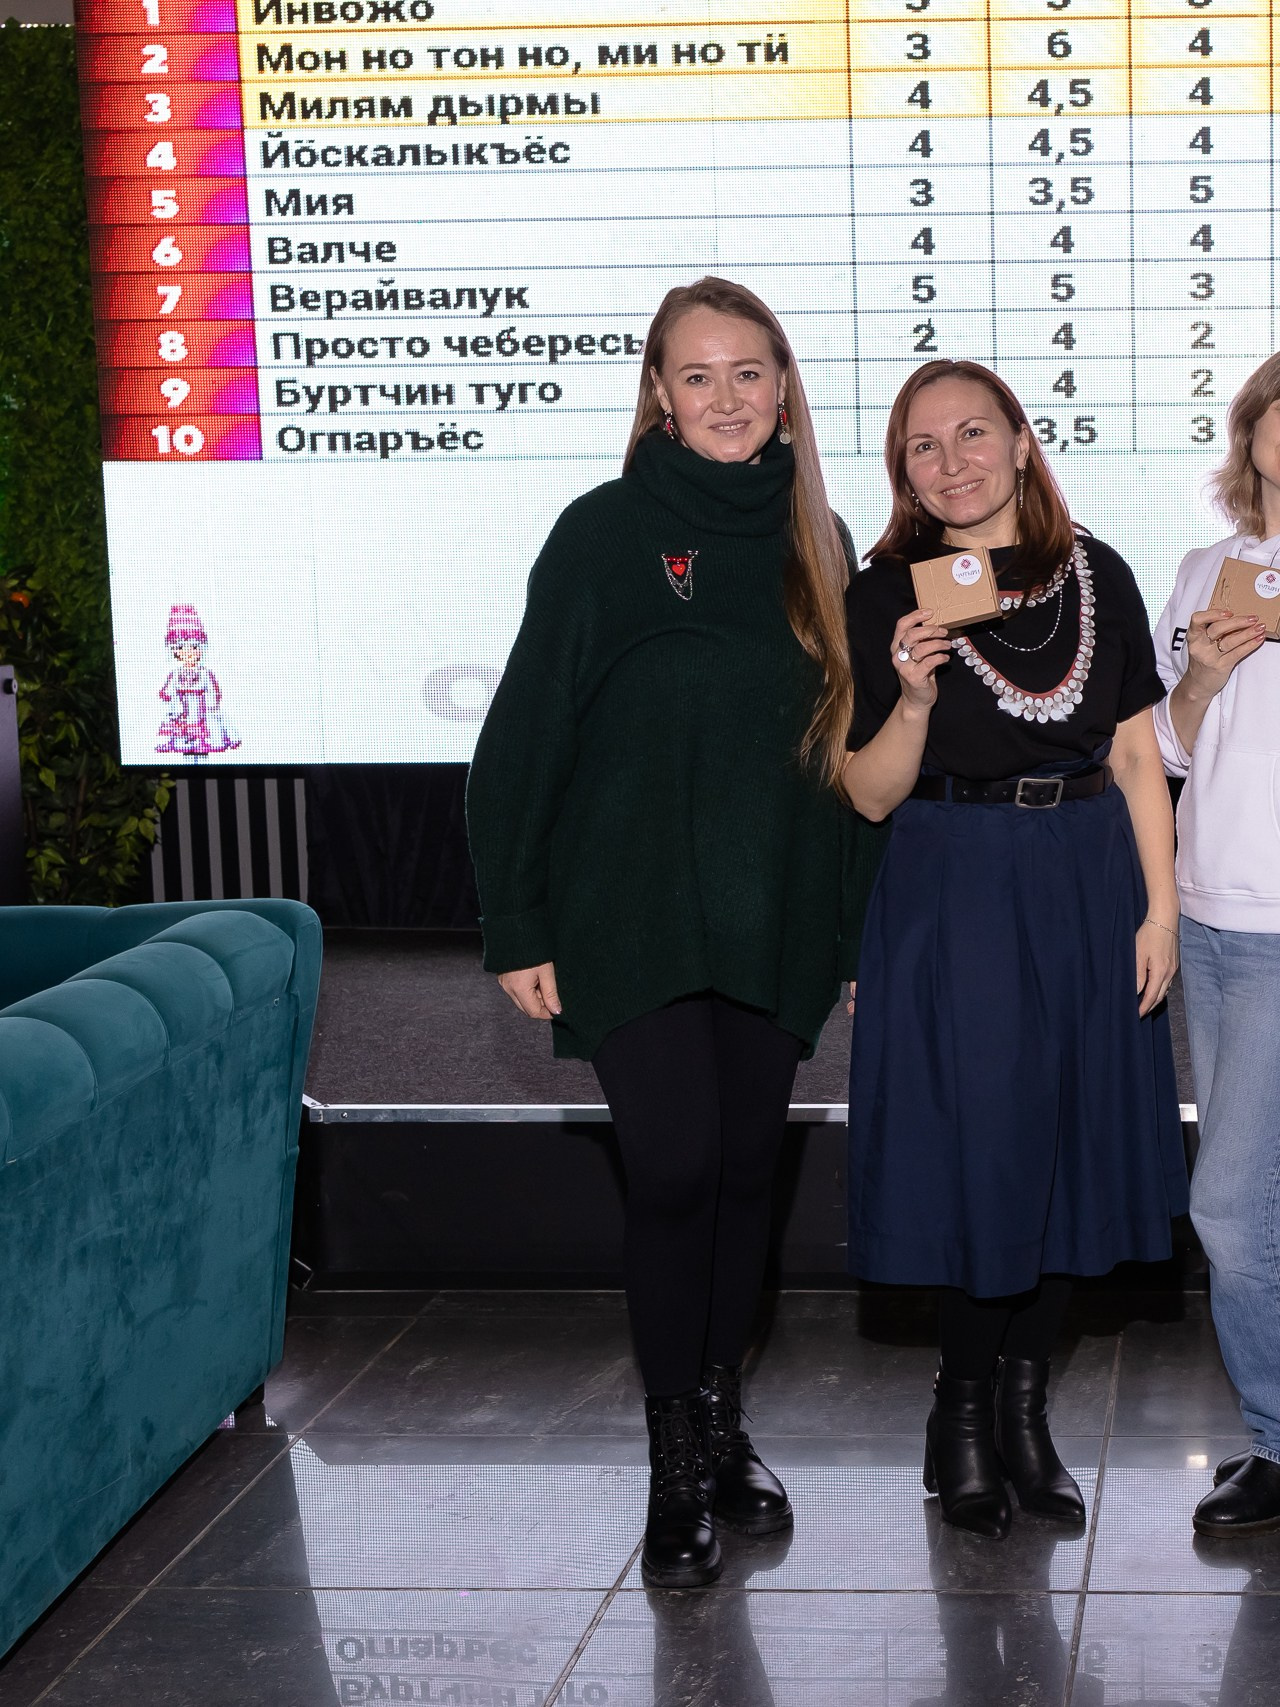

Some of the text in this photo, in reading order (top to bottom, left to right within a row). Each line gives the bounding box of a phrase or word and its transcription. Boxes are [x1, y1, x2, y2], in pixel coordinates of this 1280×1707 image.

[142, 0, 435, 26] 1 Инвожо
[141, 44, 169, 74] 2
[256, 43, 347, 72] Мон
[362, 48, 414, 71] но
[427, 47, 504, 69] тон
[518, 45, 581, 74] но,
[597, 43, 658, 66] ми
[672, 42, 725, 65] но
[906, 32, 931, 61] 3
[1047, 30, 1072, 59] 6
[1188, 28, 1213, 57] 4
[145, 92, 172, 124] 3
[259, 91, 413, 121] Милям
[427, 92, 600, 127] дырмы
[907, 80, 932, 110] 4
[1027, 78, 1093, 115] 4,5
[1188, 77, 1213, 106] 4
[146, 141, 177, 171] 4
[908, 129, 932, 158] 4
[1028, 128, 1093, 163] 4,5
[1189, 126, 1213, 155] 4
[151, 189, 180, 219] 5
[264, 188, 354, 217] Мия
[910, 178, 934, 207] 3
[1029, 177, 1094, 213] 3,5
[1190, 175, 1213, 203] 5
[152, 236, 183, 267] 6
[267, 236, 397, 265] Валче
[910, 227, 935, 256] 4
[1050, 225, 1074, 254] 4
[1190, 224, 1214, 252] 4
[156, 285, 182, 315] 7
[269, 279, 529, 318] Верайвалук
[912, 275, 936, 304] 5
[1051, 273, 1075, 302] 5
[1189, 271, 1215, 301] 3
[158, 330, 188, 362] 8
[271, 332, 431, 364] Просто
[913, 320, 938, 353] 2
[1052, 322, 1076, 351] 4
[1190, 321, 1215, 350] 2
[160, 377, 191, 408] 9
[275, 379, 455, 410] Буртчин
[469, 382, 563, 410] туго
[1052, 370, 1077, 398] 4
[1191, 368, 1214, 397] 2
[152, 424, 204, 455] 10
[277, 425, 483, 459] Огпаръёс
[1032, 415, 1099, 453] 3,5
[1190, 415, 1216, 444] 3
